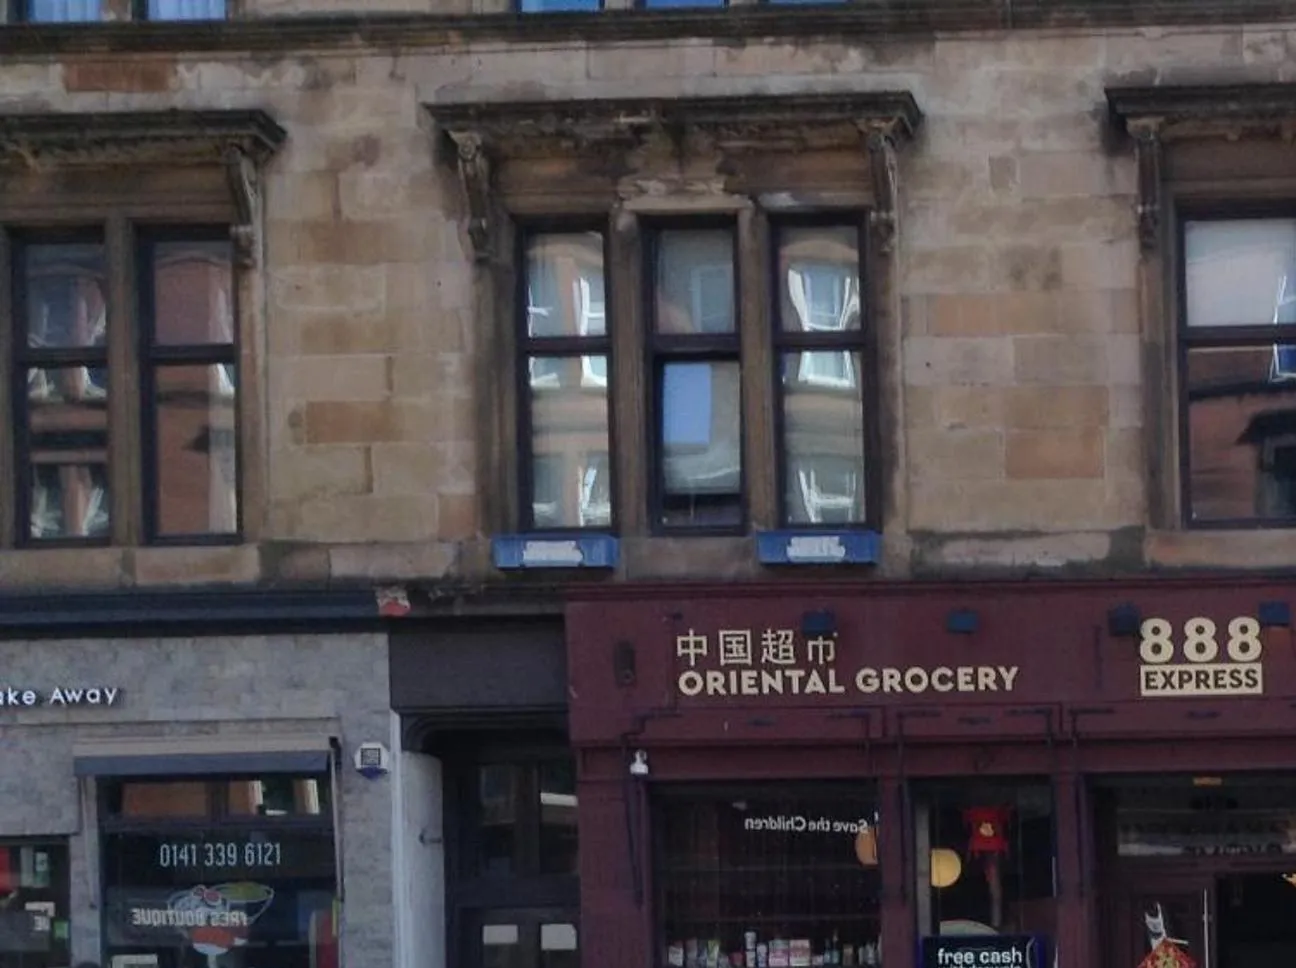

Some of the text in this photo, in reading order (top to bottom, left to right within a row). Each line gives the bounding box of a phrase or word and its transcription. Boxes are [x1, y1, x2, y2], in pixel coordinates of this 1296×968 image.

[676, 628, 839, 667] 中国超市
[1140, 616, 1262, 663] 888
[678, 666, 1020, 697] ORIENTAL GROCERY
[1144, 668, 1259, 690] EXPRESS
[0, 686, 118, 706] ke Away
[160, 843, 281, 867] 0141 339 6121
[938, 946, 1022, 965] free cash
